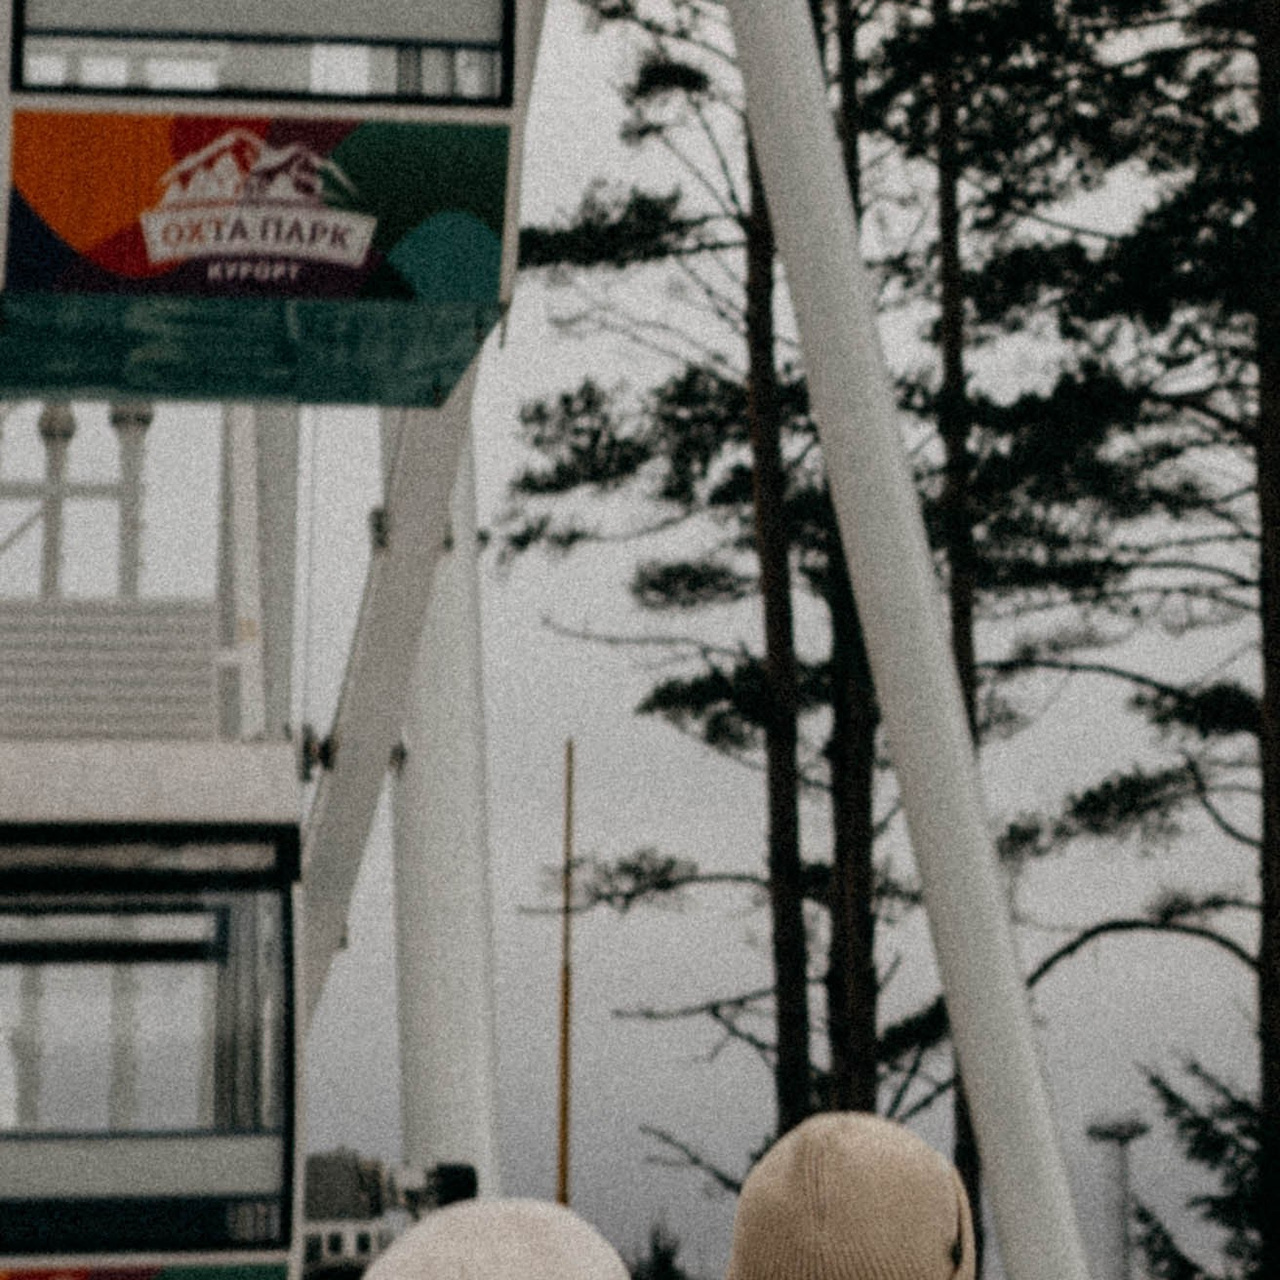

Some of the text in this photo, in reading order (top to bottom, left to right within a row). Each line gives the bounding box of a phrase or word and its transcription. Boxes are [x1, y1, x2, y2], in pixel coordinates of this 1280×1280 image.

[161, 216, 352, 247] ОХТА ПАРК
[206, 261, 302, 282] КУРОРТ
